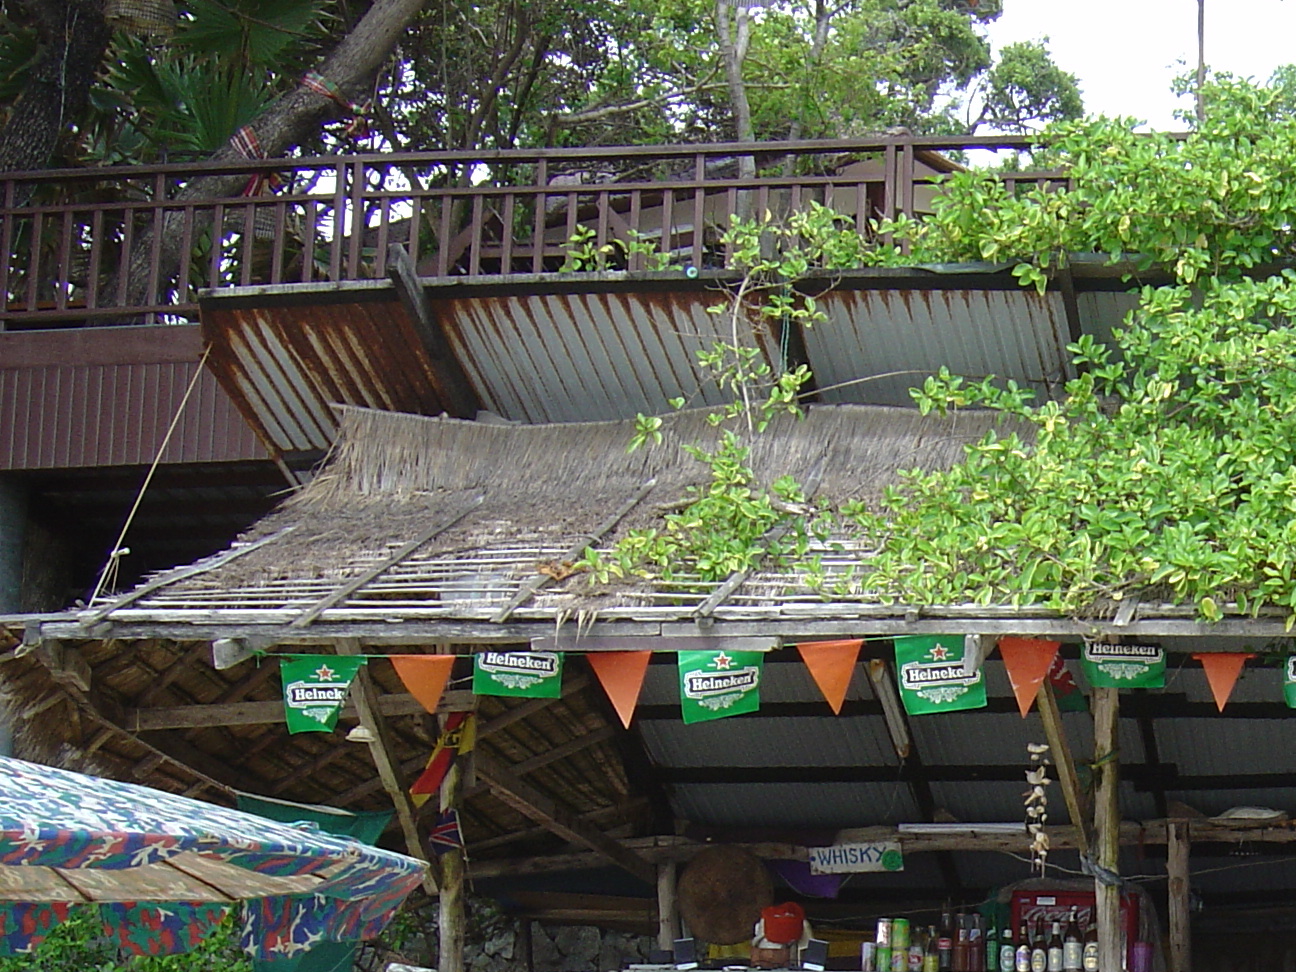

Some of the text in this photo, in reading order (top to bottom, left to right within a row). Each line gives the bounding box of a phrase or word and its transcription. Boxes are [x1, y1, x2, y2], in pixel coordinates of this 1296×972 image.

[487, 652, 552, 670] Heineken
[692, 675, 752, 691] Heineken
[909, 667, 964, 682] Heineke
[817, 846, 887, 866] WHISKY
